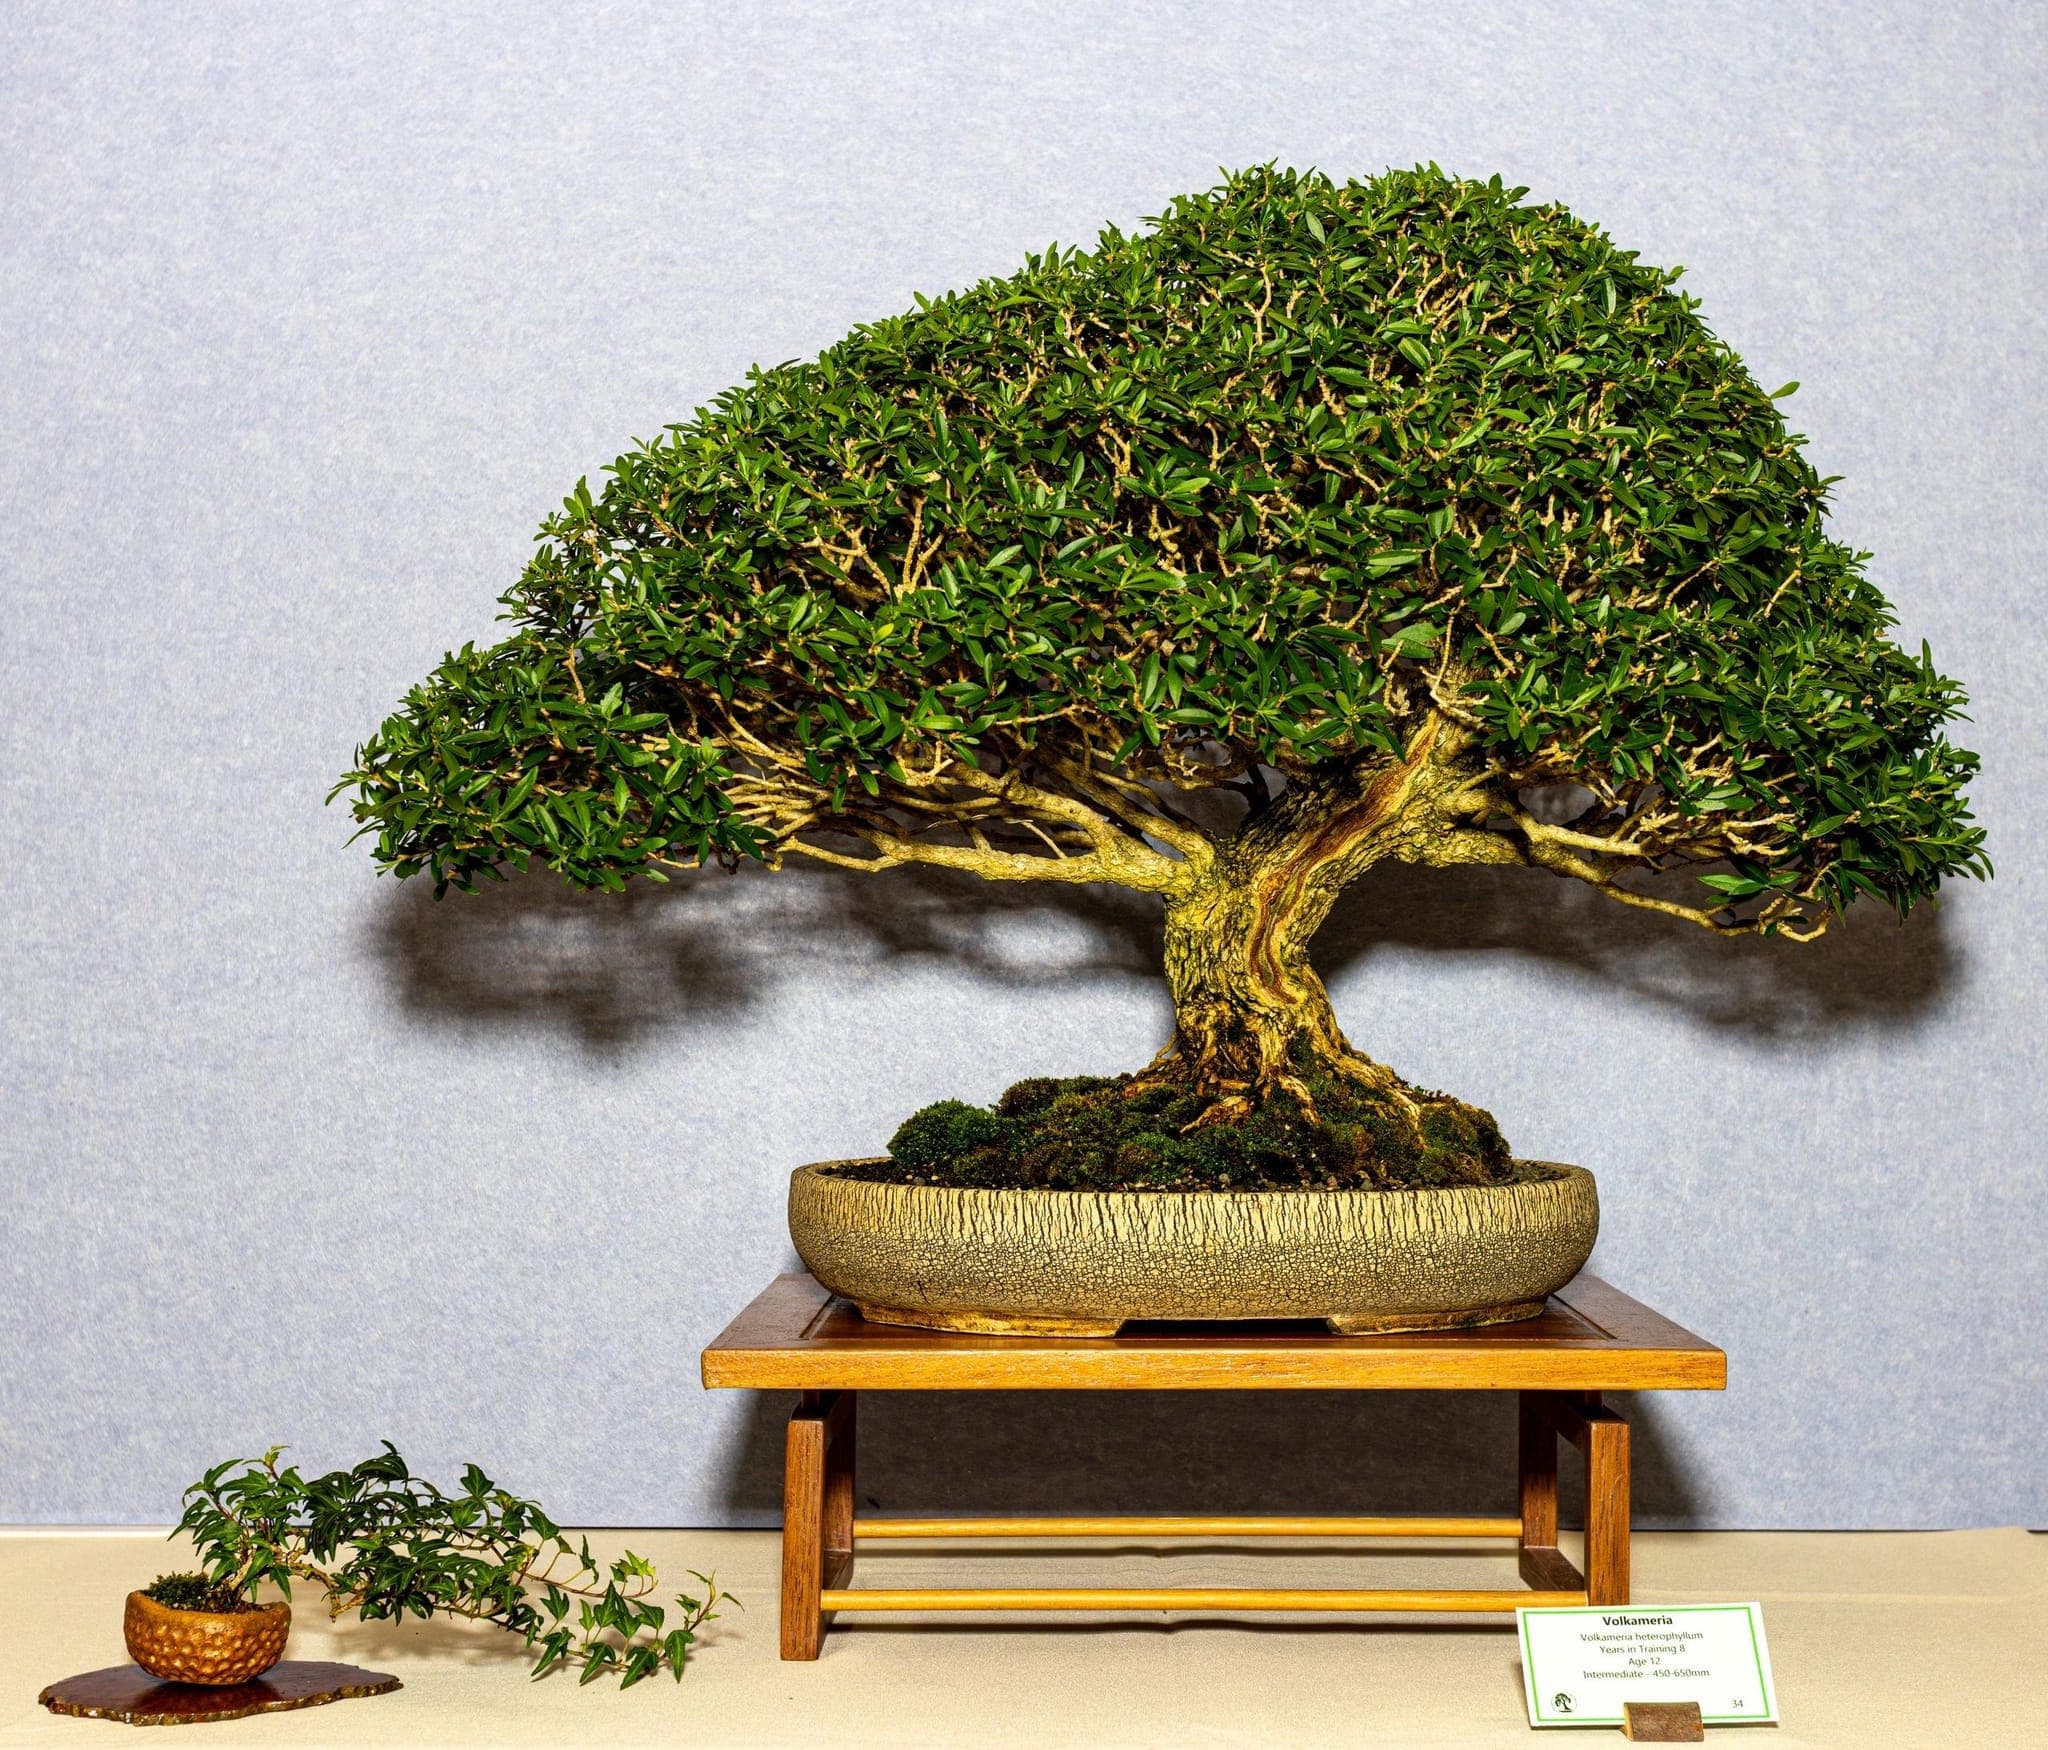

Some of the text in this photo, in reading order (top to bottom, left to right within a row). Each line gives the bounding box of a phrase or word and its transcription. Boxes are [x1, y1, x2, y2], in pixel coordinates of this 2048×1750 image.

[1602, 1615, 1673, 1626] Volkameria
[1580, 1631, 1704, 1642] Volkameria heterophyllum
[1600, 1646, 1625, 1654] Years
[1639, 1644, 1677, 1655] Training
[1679, 1644, 1685, 1652] 8
[1629, 1657, 1661, 1668] Age 12
[1583, 1670, 1643, 1679] Intermediate
[1652, 1669, 1710, 1677] 450-650mm
[1731, 1699, 1744, 1708] 34
